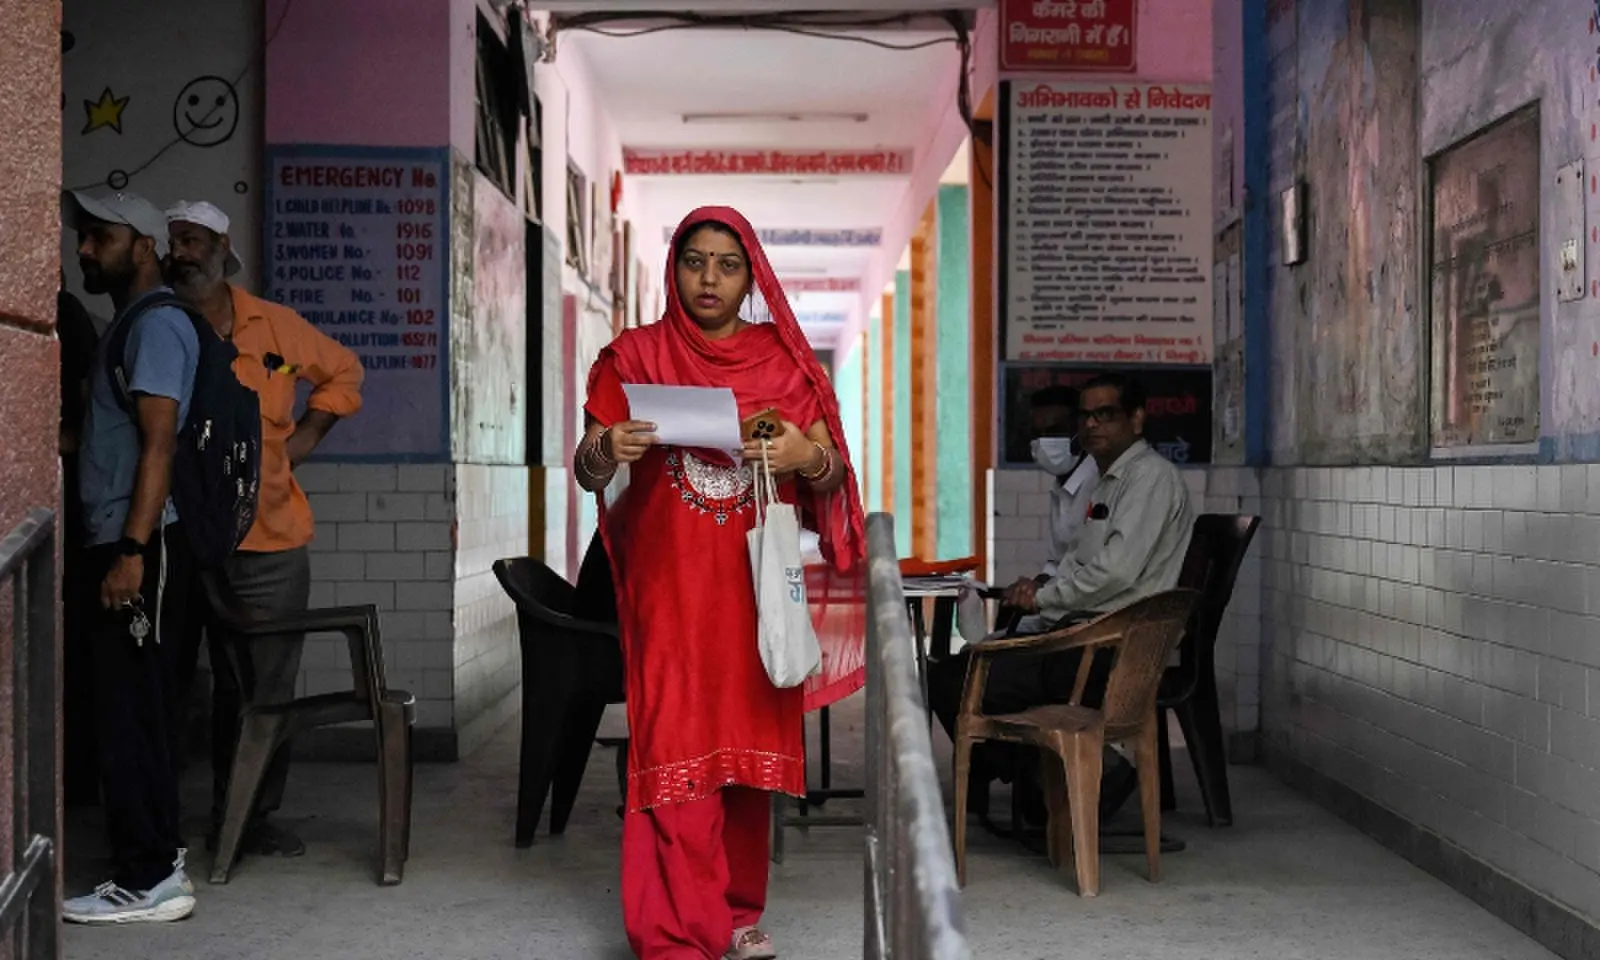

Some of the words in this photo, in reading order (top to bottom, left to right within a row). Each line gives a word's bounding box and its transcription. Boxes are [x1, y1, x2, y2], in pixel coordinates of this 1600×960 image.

[1010, 21, 1081, 45] निगरानी
[1085, 24, 1105, 44] में
[1124, 86, 1142, 109] से
[1147, 86, 1211, 110] निवेदन
[280, 165, 404, 188] EMERGENCY
[396, 199, 435, 215] 1098
[396, 221, 433, 239] 1916
[396, 243, 433, 261] 1091
[396, 264, 420, 281] 112
[396, 287, 420, 303] 101
[299, 310, 375, 326] MBULANCE
[406, 311, 434, 326] 102
